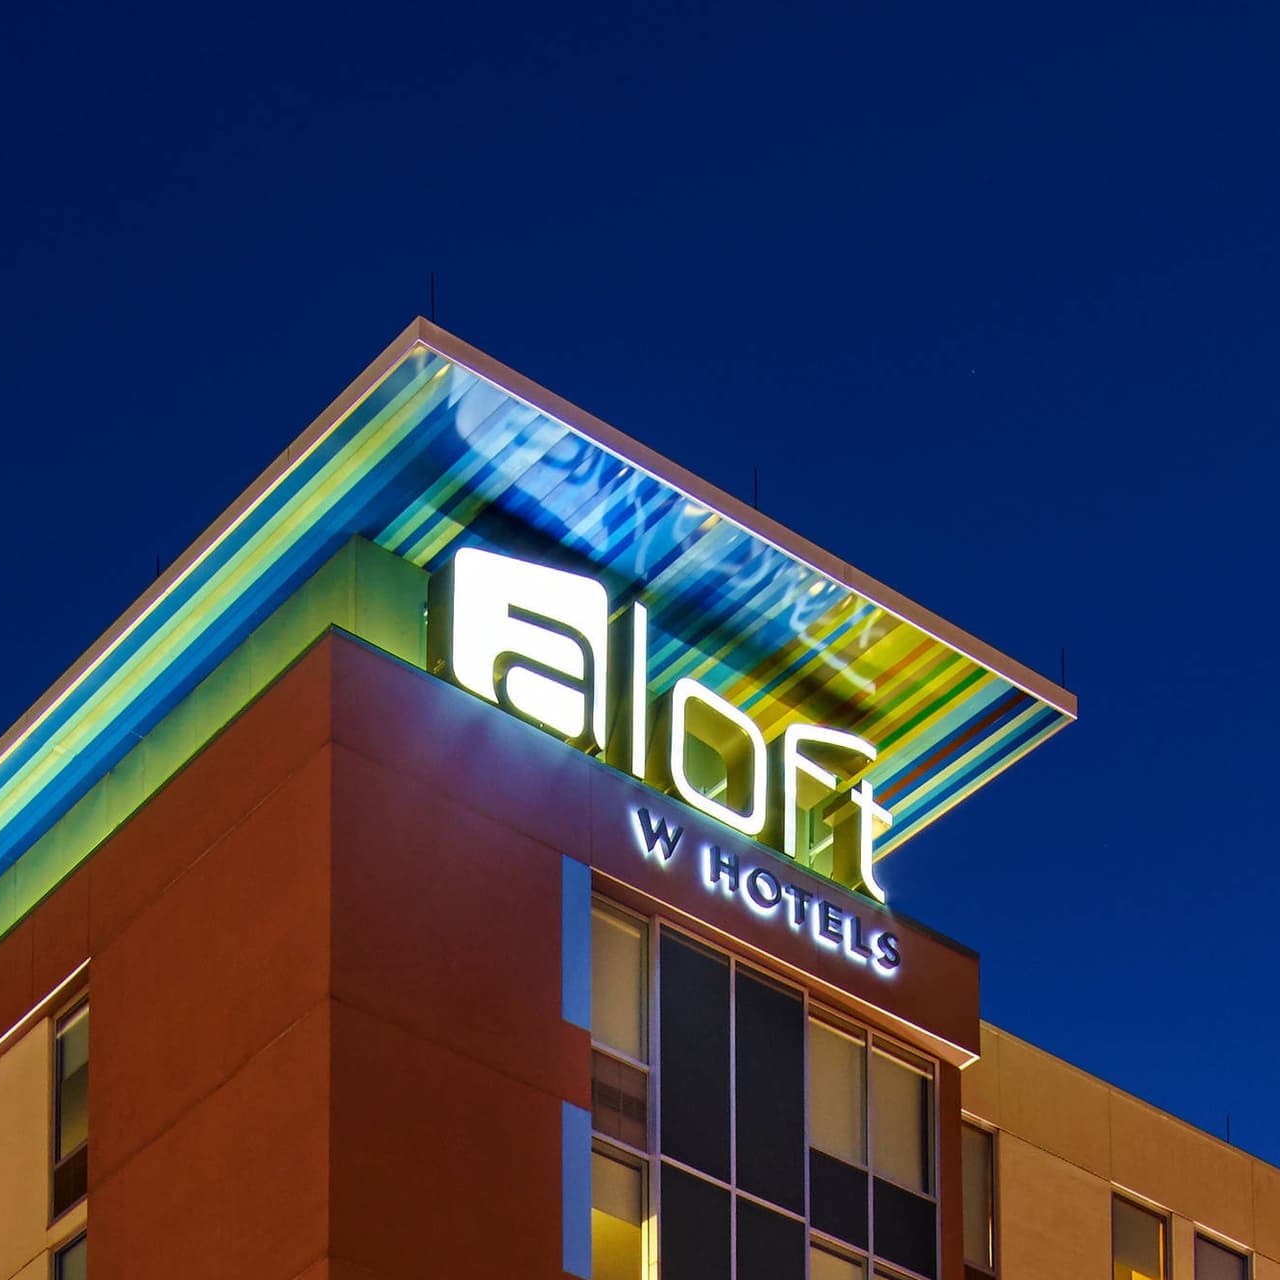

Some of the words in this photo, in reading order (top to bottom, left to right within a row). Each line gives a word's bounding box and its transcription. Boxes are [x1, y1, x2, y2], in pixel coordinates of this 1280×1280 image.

[452, 546, 894, 905] aloft
[634, 805, 685, 863] W
[707, 844, 902, 972] HOTELS
